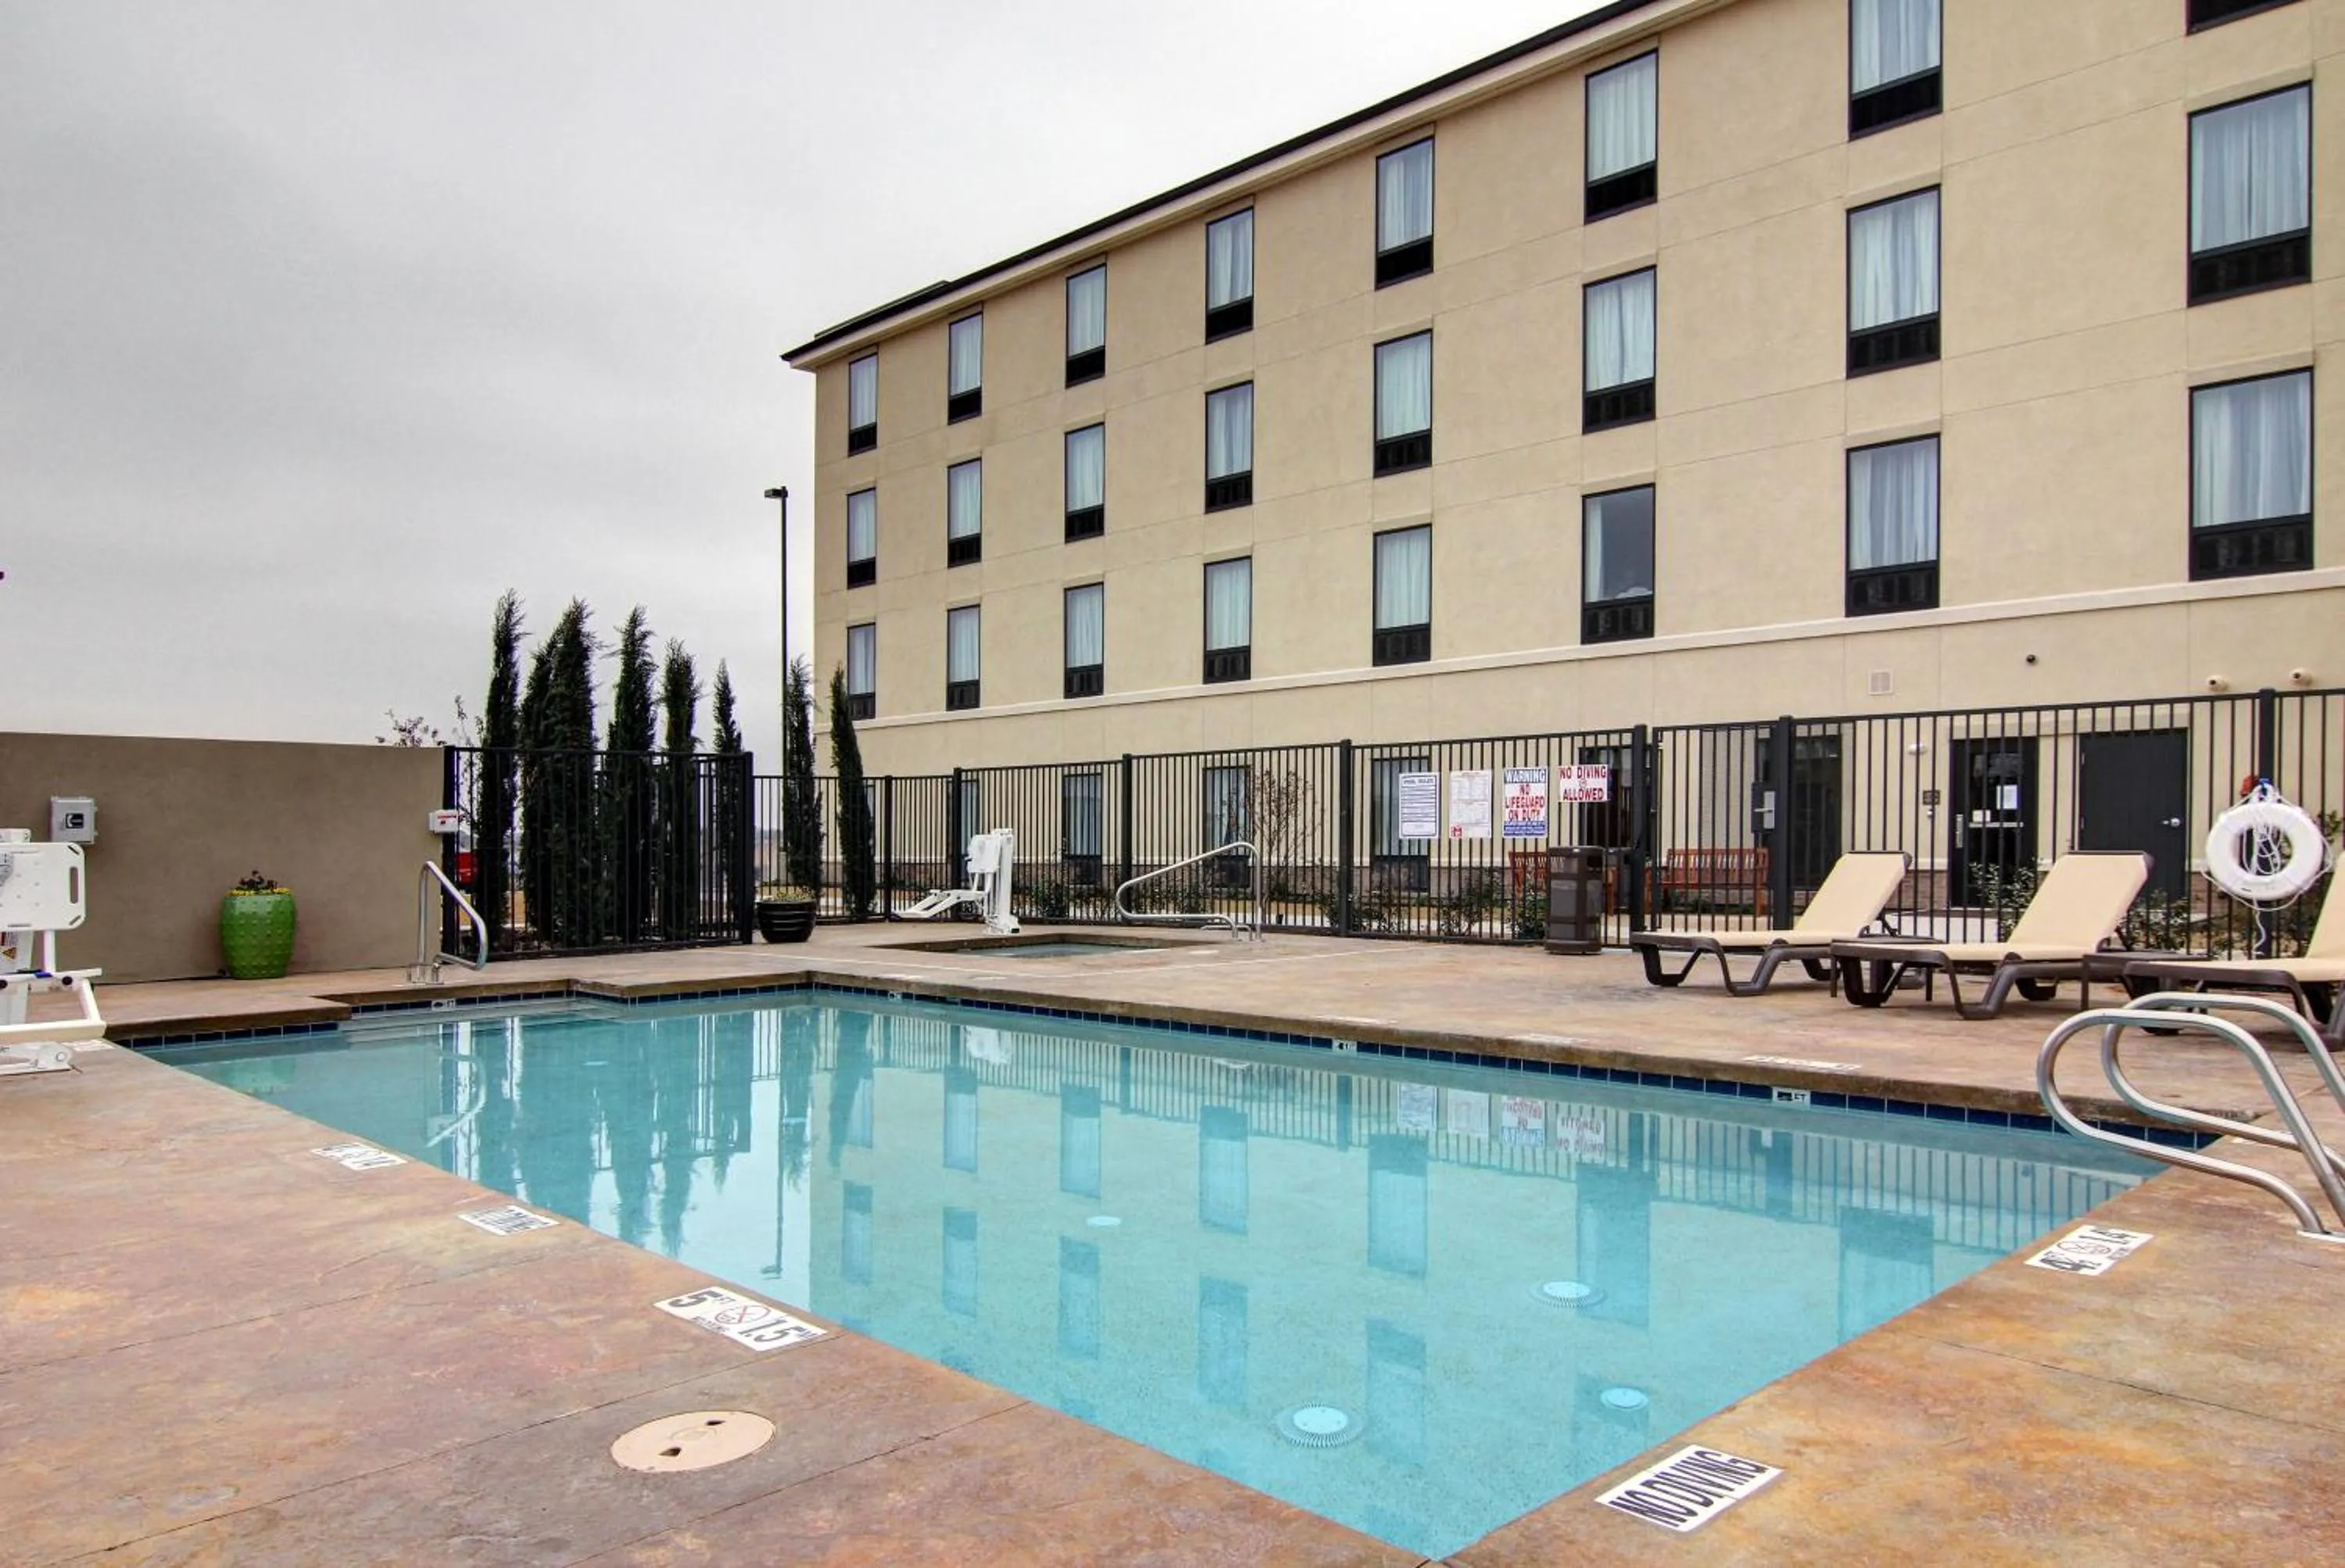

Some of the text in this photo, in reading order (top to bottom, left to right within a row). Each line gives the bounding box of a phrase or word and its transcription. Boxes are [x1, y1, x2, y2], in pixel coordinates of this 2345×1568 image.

[1505, 769, 1545, 782] WARNING
[1559, 766, 1606, 779] NO DIVING
[1520, 784, 1530, 795] NO
[1563, 788, 1603, 800] ALLOWED
[1505, 796, 1545, 808] LIFEGUARD
[1509, 810, 1541, 821] ON DUTY
[668, 1290, 724, 1308] 5
[1608, 1450, 1768, 1527] NO DIVING
